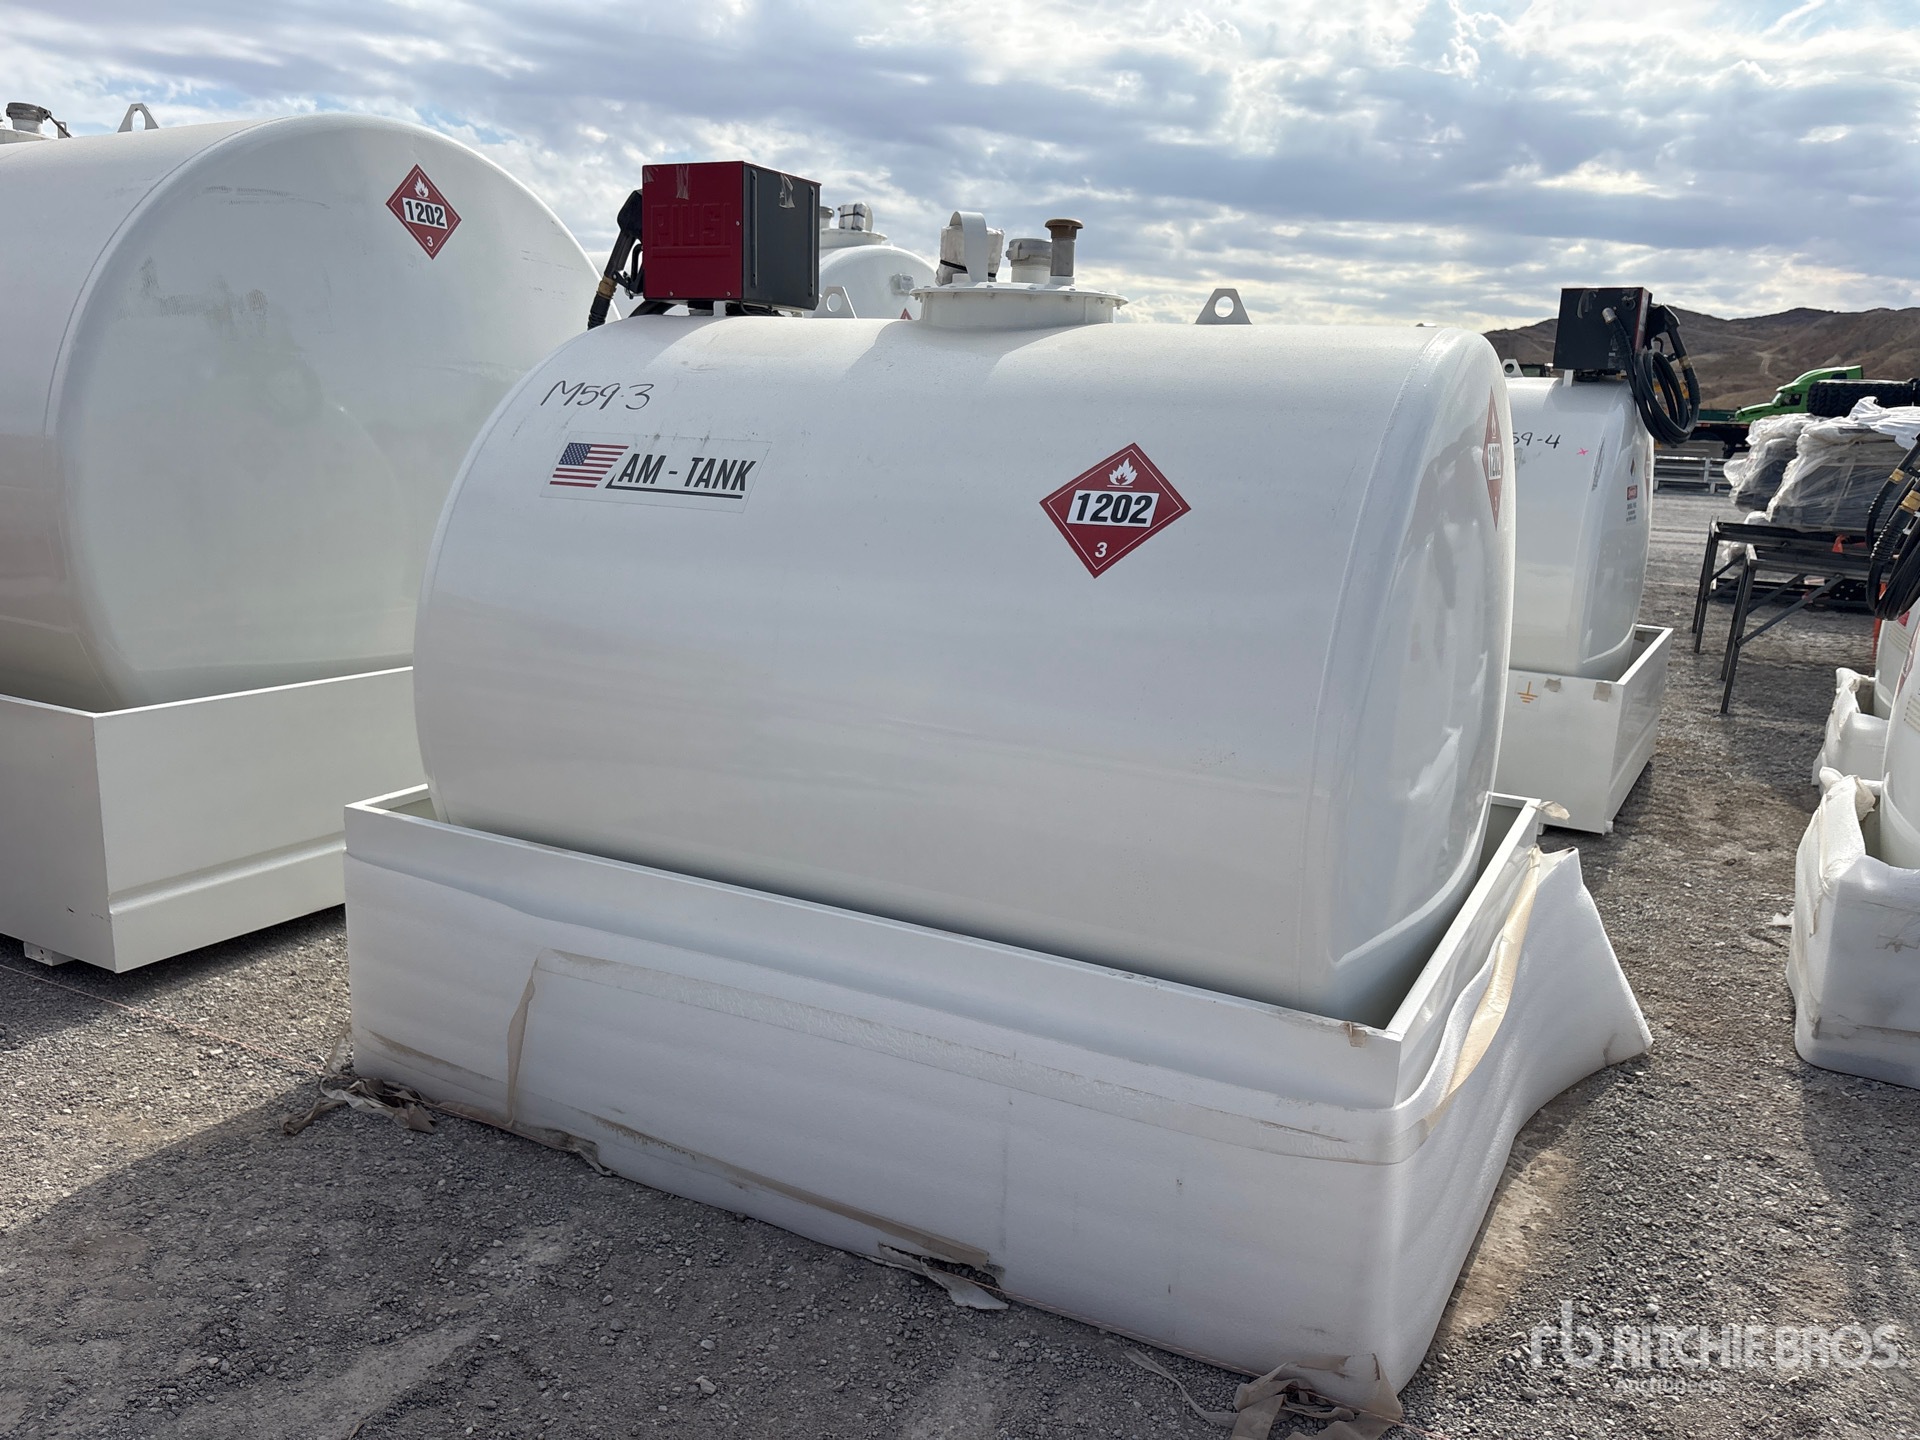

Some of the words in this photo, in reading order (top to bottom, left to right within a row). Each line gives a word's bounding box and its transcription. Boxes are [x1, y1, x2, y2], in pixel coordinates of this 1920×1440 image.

[405, 200, 446, 228] 1202
[651, 203, 732, 247] PIUSI
[426, 235, 434, 247] 3
[617, 453, 667, 485] AM
[684, 456, 757, 492] TANK
[1076, 492, 1153, 525] 1202
[1094, 541, 1108, 558] 3
